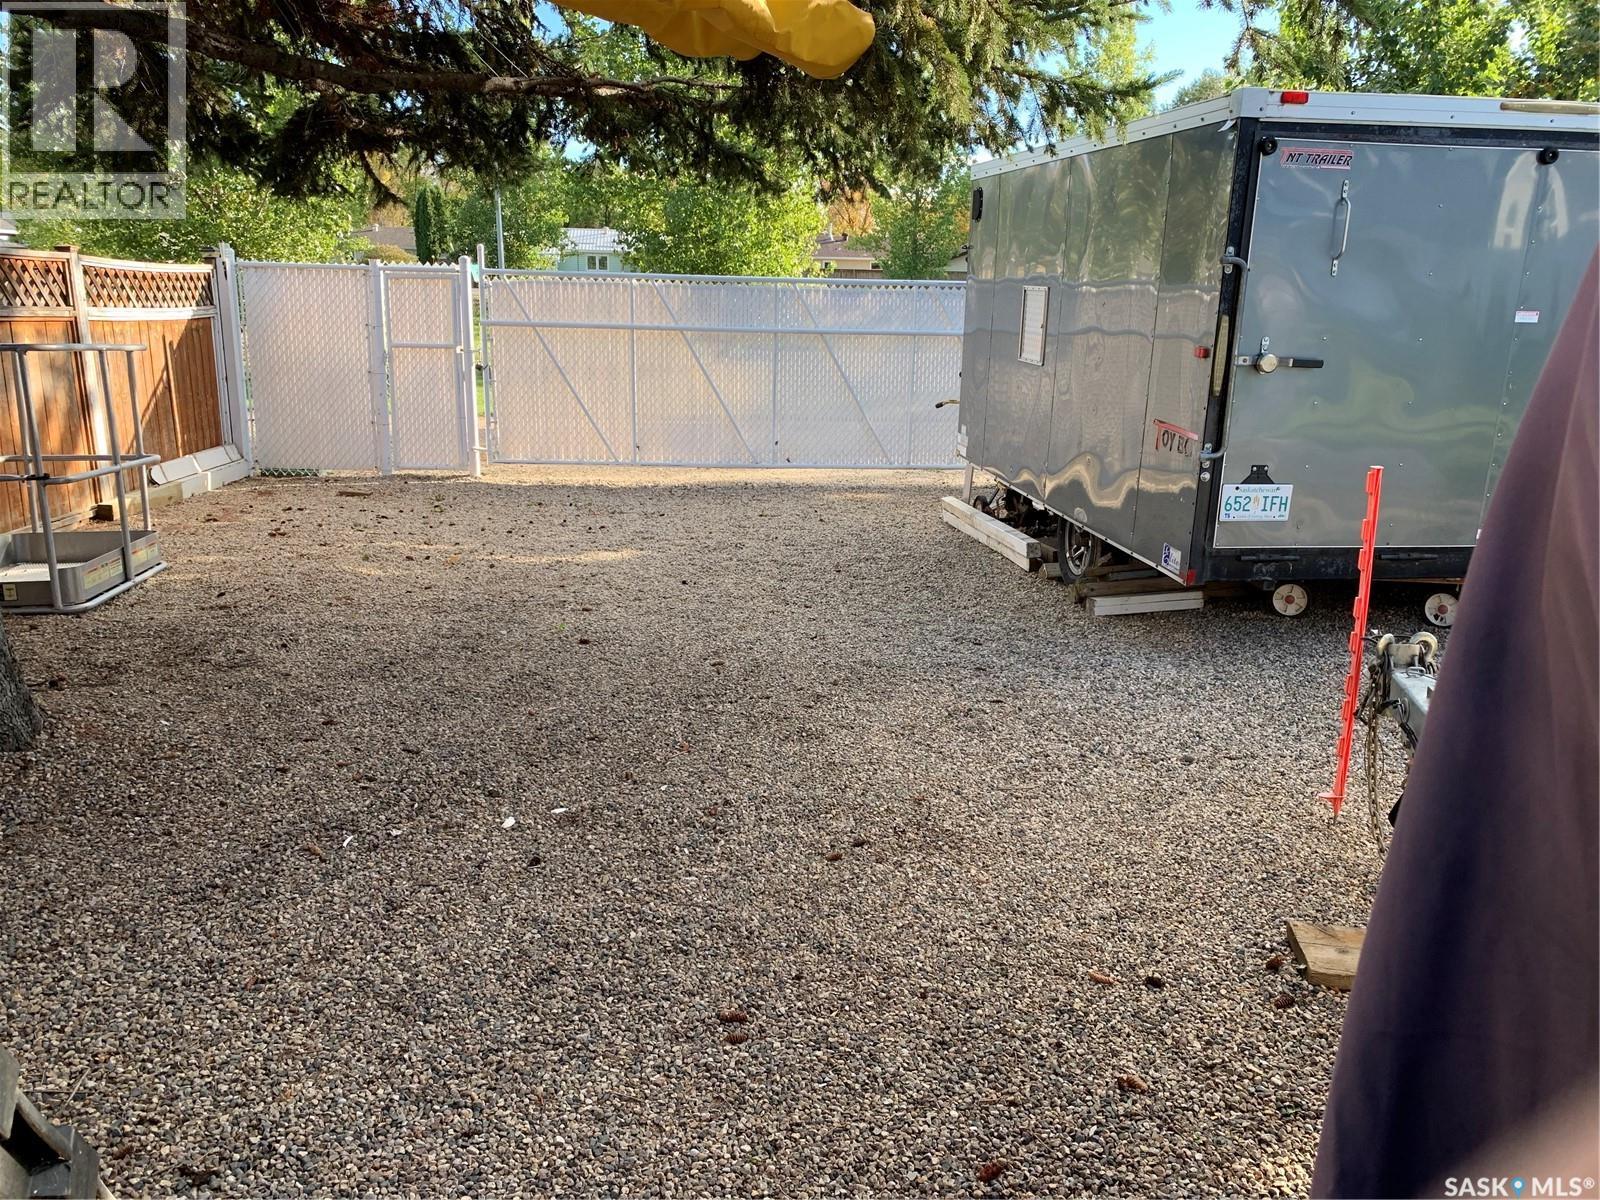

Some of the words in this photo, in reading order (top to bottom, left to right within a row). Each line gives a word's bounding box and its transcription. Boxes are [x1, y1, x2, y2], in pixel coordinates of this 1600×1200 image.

[1305, 153, 1353, 166] TRAILER
[1224, 496, 1251, 512] 652
[1261, 495, 1288, 512] IFH
